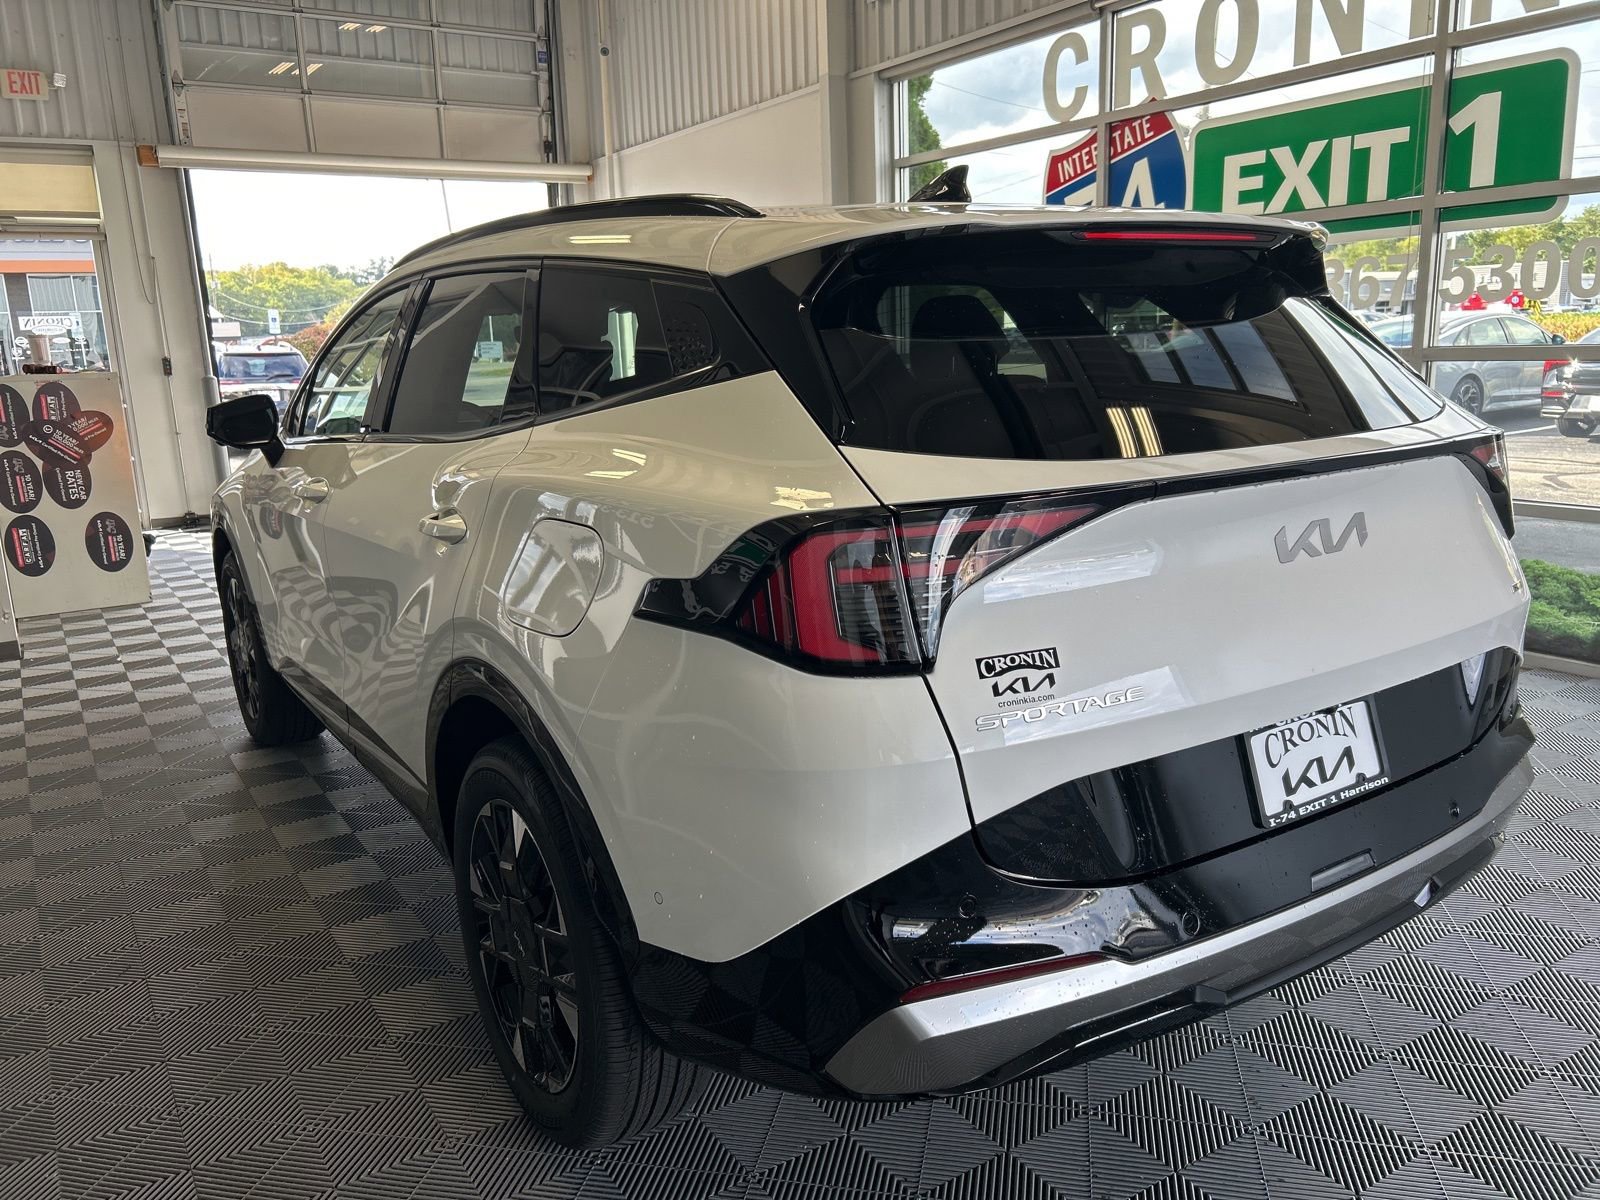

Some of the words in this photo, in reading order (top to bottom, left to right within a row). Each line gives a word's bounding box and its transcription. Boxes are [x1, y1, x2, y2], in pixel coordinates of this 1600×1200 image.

[1042, 0, 1560, 123] CRON
[7, 71, 40, 95] EXIT
[1057, 115, 1154, 183] INTETATE
[1222, 126, 1411, 216] EXIT
[1449, 91, 1502, 189] 1
[1438, 236, 1600, 305] 5300
[55, 429, 62, 437] 10
[62, 433, 79, 446] YEAR/
[25, 474, 32, 482] 10
[26, 482, 36, 500] YEAR/
[65, 470, 80, 500] RATES
[75, 469, 84, 486] NEW
[78, 485, 87, 500] CAR
[18, 528, 33, 565] CARFAX
[116, 534, 123, 542] 10
[117, 541, 127, 560] YEAR/
[1274, 512, 1368, 563] KIA
[980, 649, 1056, 678] CRONIN
[991, 672, 1056, 697] KIA
[975, 686, 1144, 732] SPORTAGE
[998, 693, 1055, 708] croninkia.com
[1264, 706, 1357, 768] CRONIN
[1281, 745, 1355, 797] KIA
[1268, 810, 1297, 827] I-74
[1299, 798, 1327, 816] EXIT
[1330, 795, 1338, 804] 1
[1340, 776, 1389, 800] Harrison
